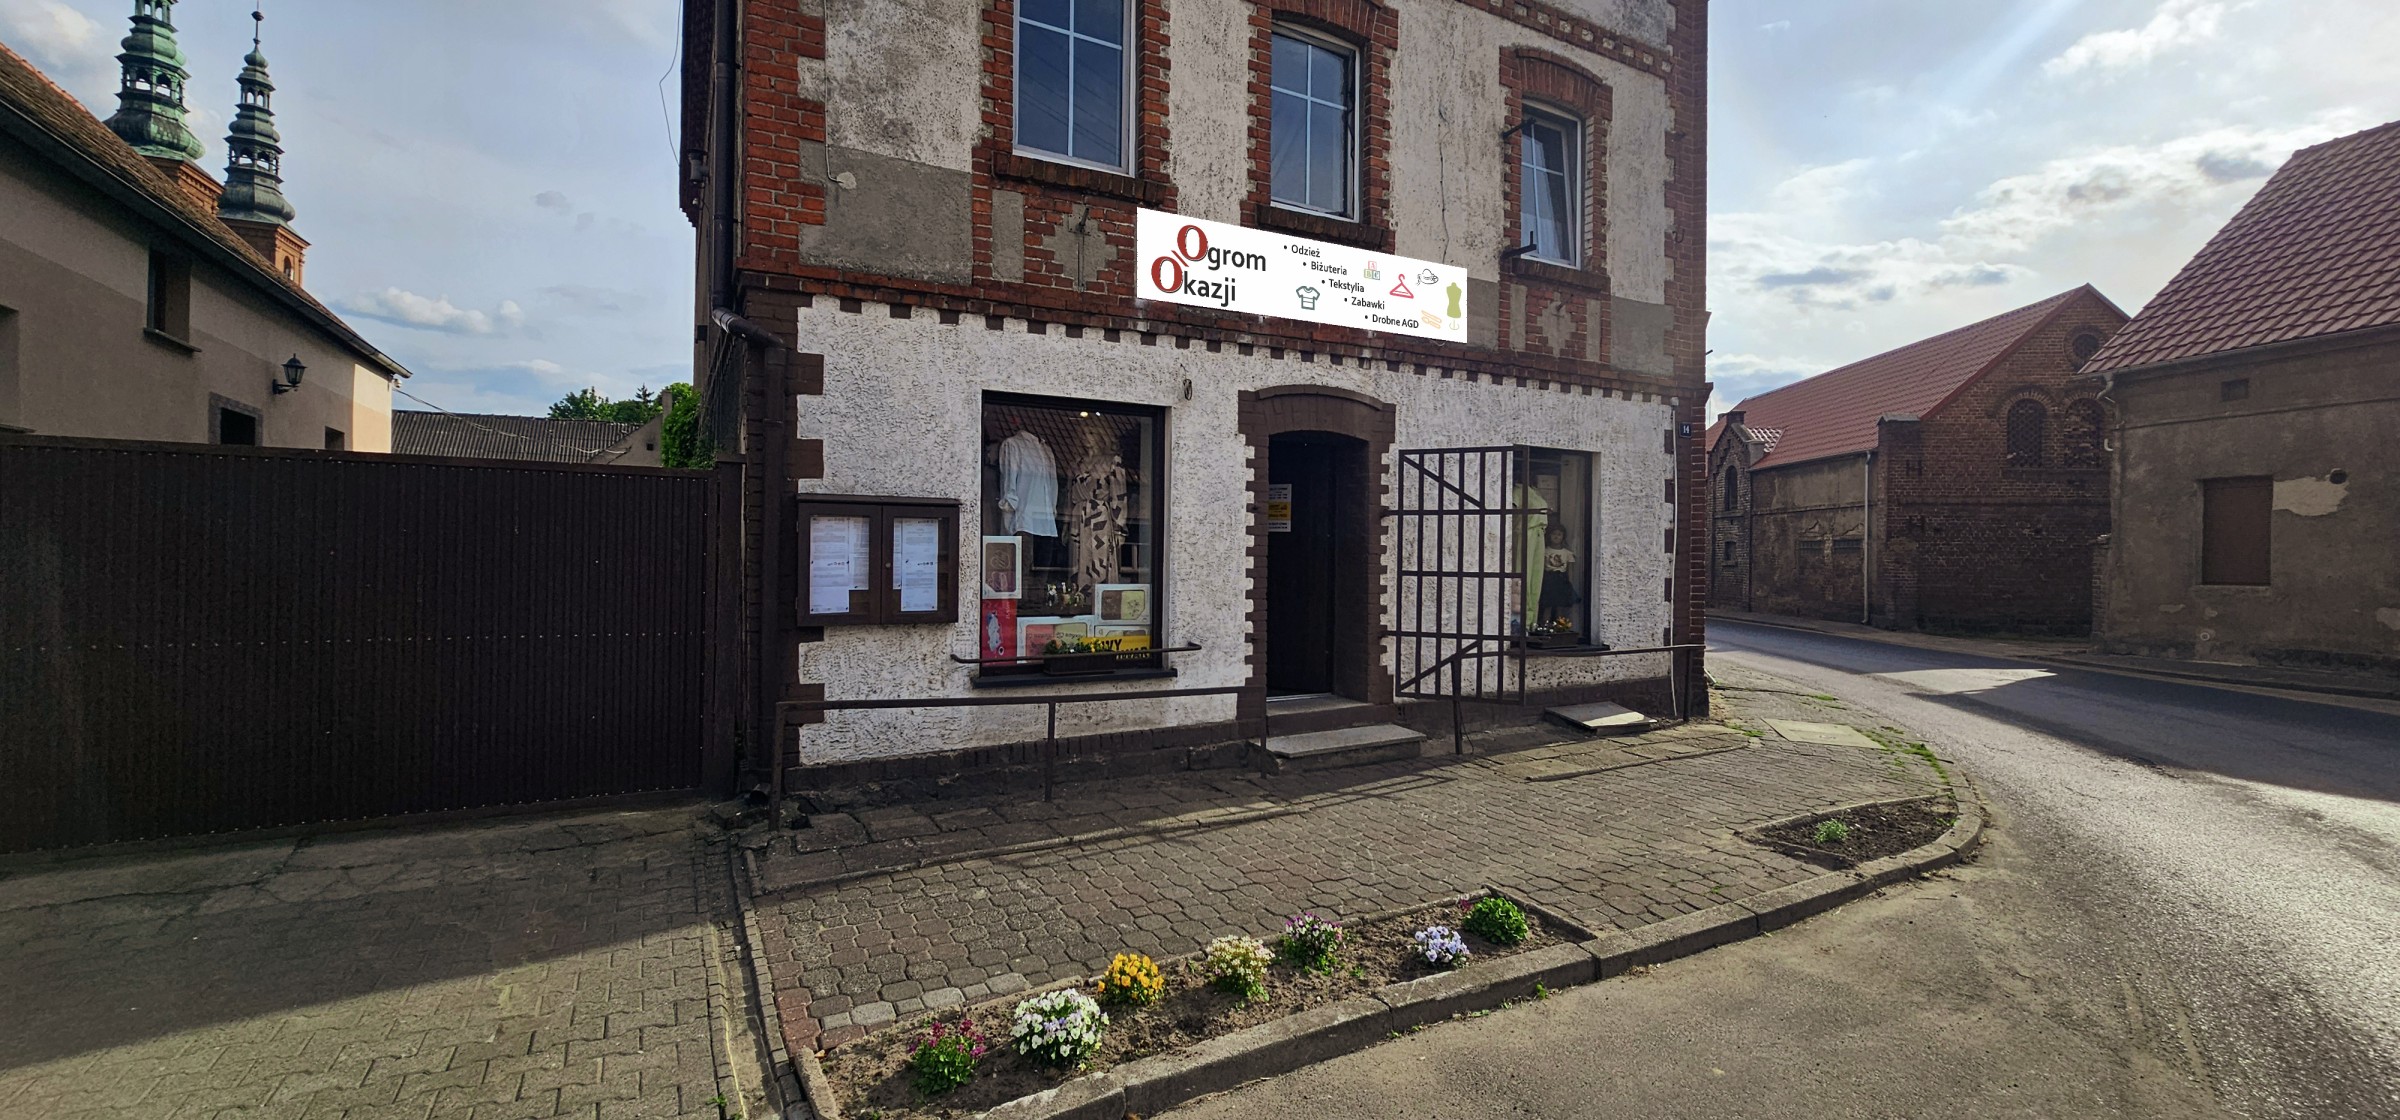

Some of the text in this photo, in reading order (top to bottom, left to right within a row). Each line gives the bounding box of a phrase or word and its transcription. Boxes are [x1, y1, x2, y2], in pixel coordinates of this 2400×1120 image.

[1177, 225, 1266, 271] Ogrom
[1291, 244, 1321, 258] Odzież
[1311, 260, 1347, 276] Biżuteria
[1151, 256, 1235, 307] Okazji
[1328, 278, 1365, 293] Tekstylia
[1351, 296, 1385, 310] Zabawki
[1372, 313, 1419, 329] Drobne AGD
